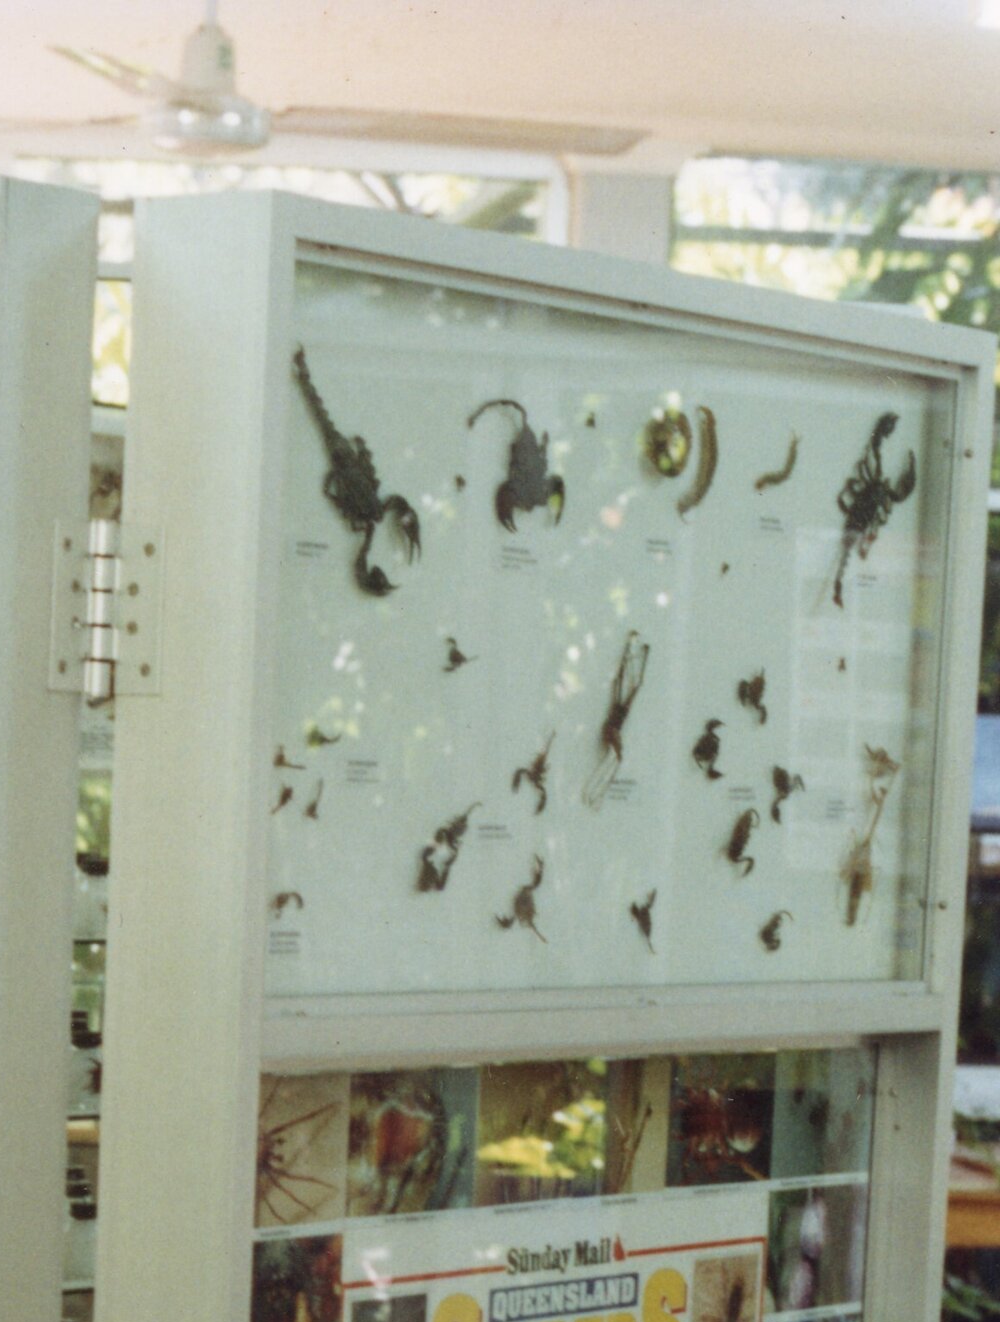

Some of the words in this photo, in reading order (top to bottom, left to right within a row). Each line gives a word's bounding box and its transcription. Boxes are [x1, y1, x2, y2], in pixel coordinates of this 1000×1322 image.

[506, 1244, 570, 1275] Sunday
[574, 1237, 611, 1267] Mail
[492, 1276, 635, 1322] QUEENSLAND
